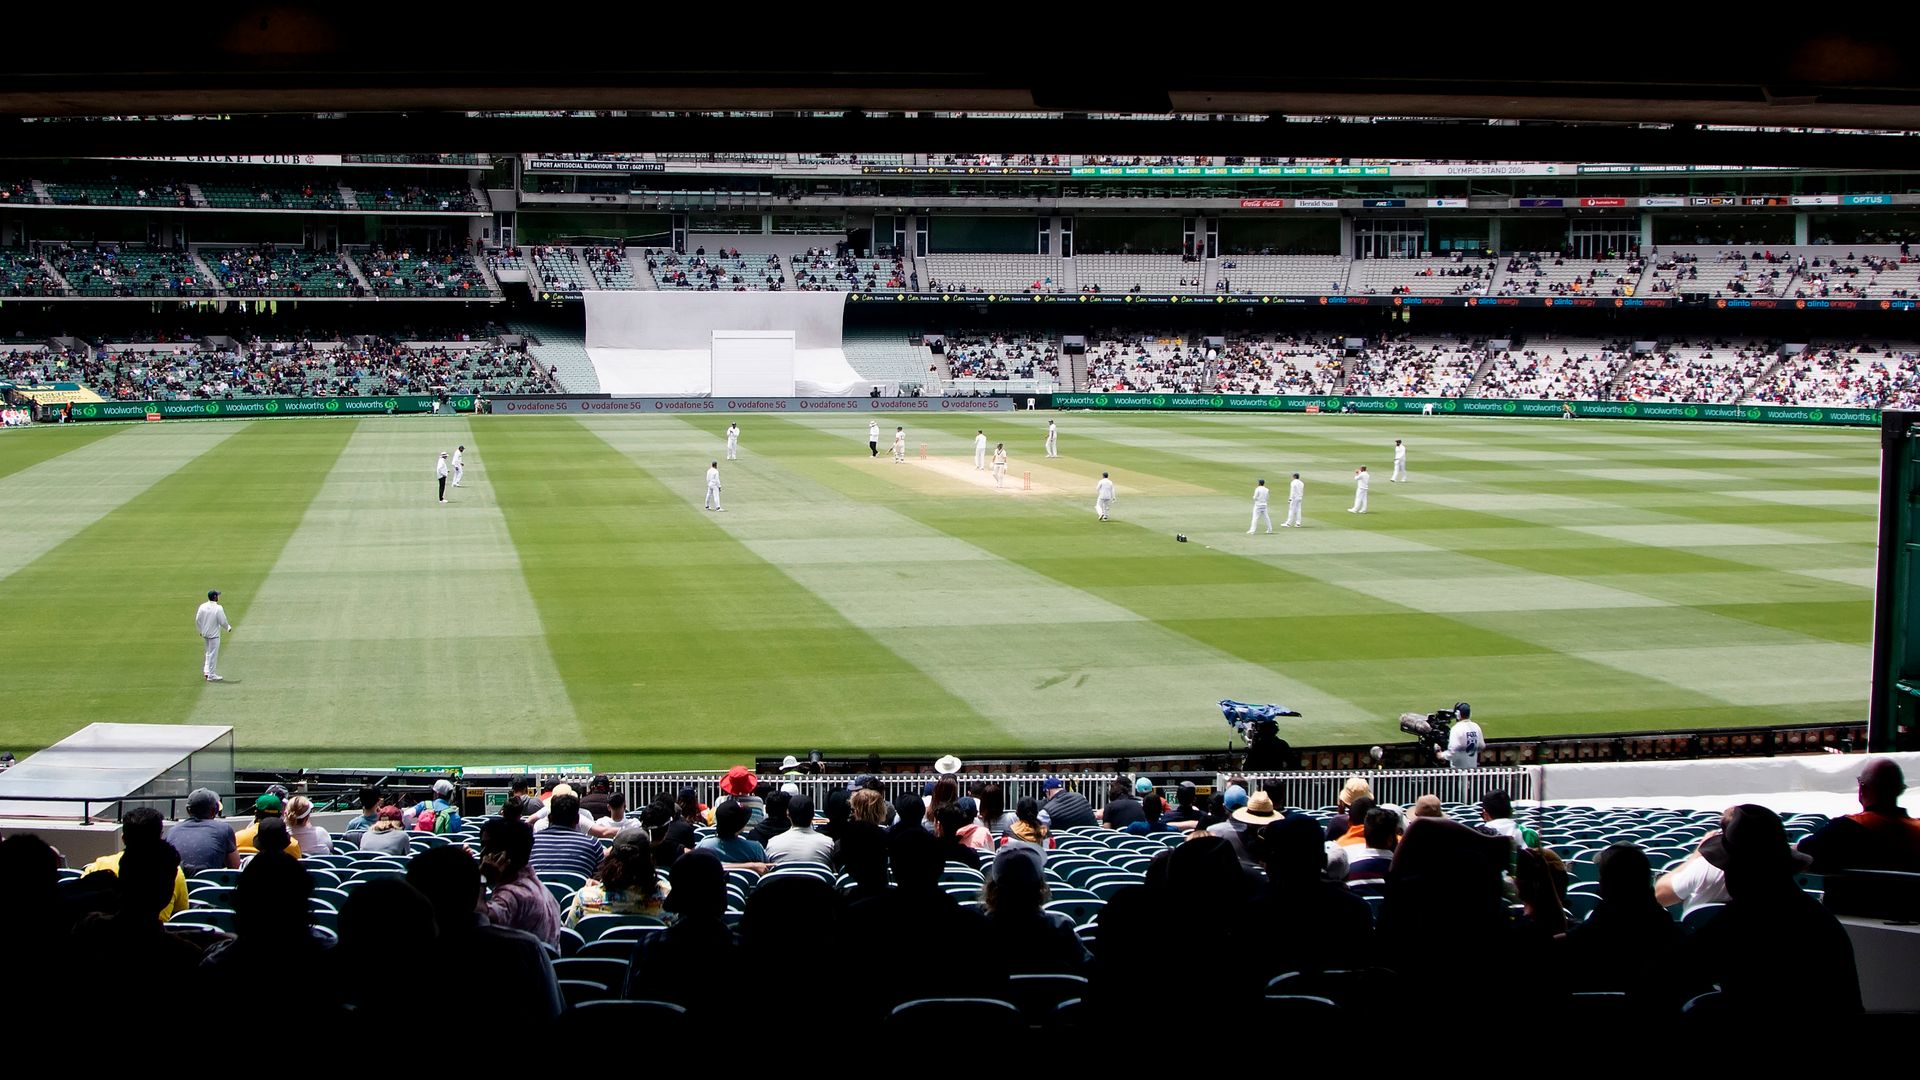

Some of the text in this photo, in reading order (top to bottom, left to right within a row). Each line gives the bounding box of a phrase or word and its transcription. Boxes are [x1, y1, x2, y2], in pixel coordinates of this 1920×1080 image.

[263, 155, 300, 164] CLUB
[1751, 300, 1777, 308] energy
[1830, 300, 1857, 308] energy
[165, 405, 205, 413] Woolworths
[1644, 407, 1683, 415] Woolworths
[1768, 410, 1808, 419] Woolworths
[1830, 412, 1871, 421] Woolworths
